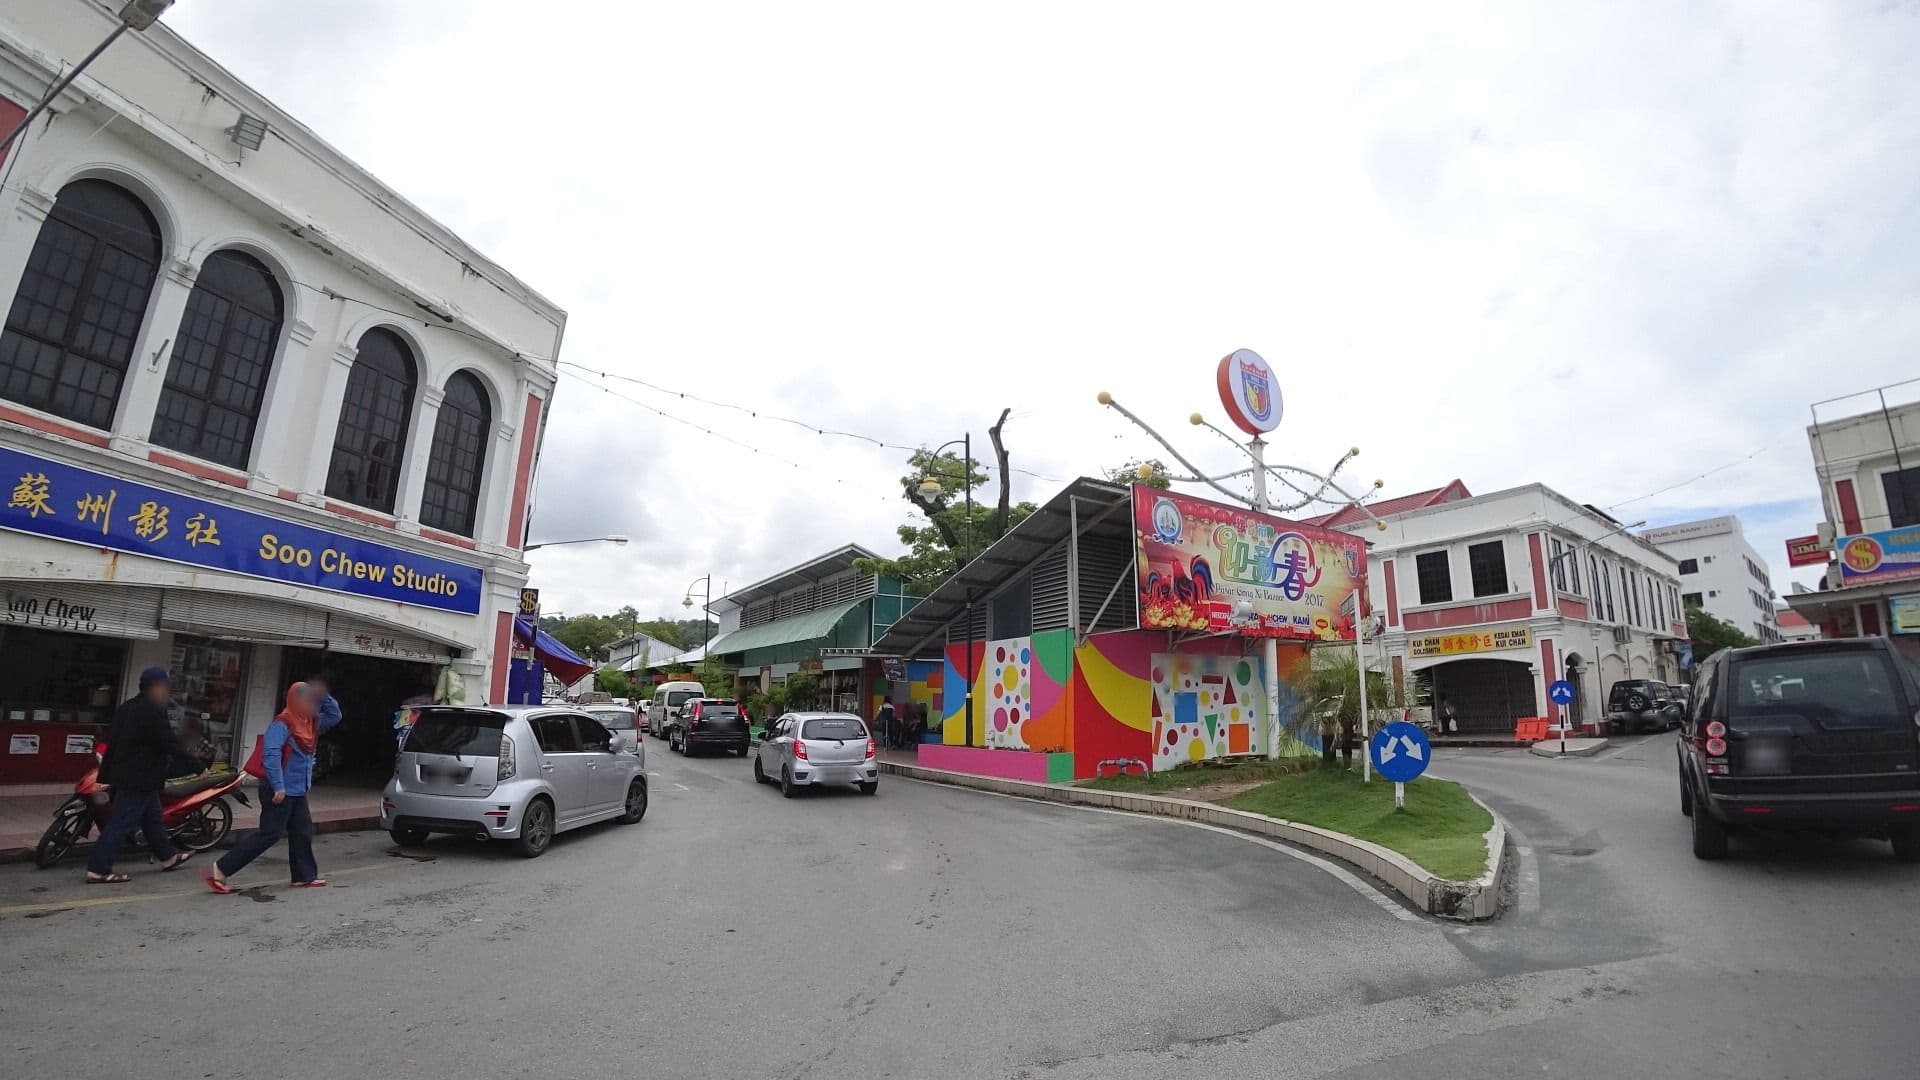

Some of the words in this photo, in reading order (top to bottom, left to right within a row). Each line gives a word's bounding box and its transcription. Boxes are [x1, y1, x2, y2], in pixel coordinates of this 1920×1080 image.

[8, 472, 221, 547] 蘇州影社
[259, 534, 312, 567] Soo
[320, 548, 386, 583] Chew
[391, 564, 458, 597] Studio
[1304, 592, 1325, 608] 2017
[1425, 637, 1440, 645] CHAN
[1496, 640, 1507, 648] KUI
[1508, 638, 1526, 647] CHAN
